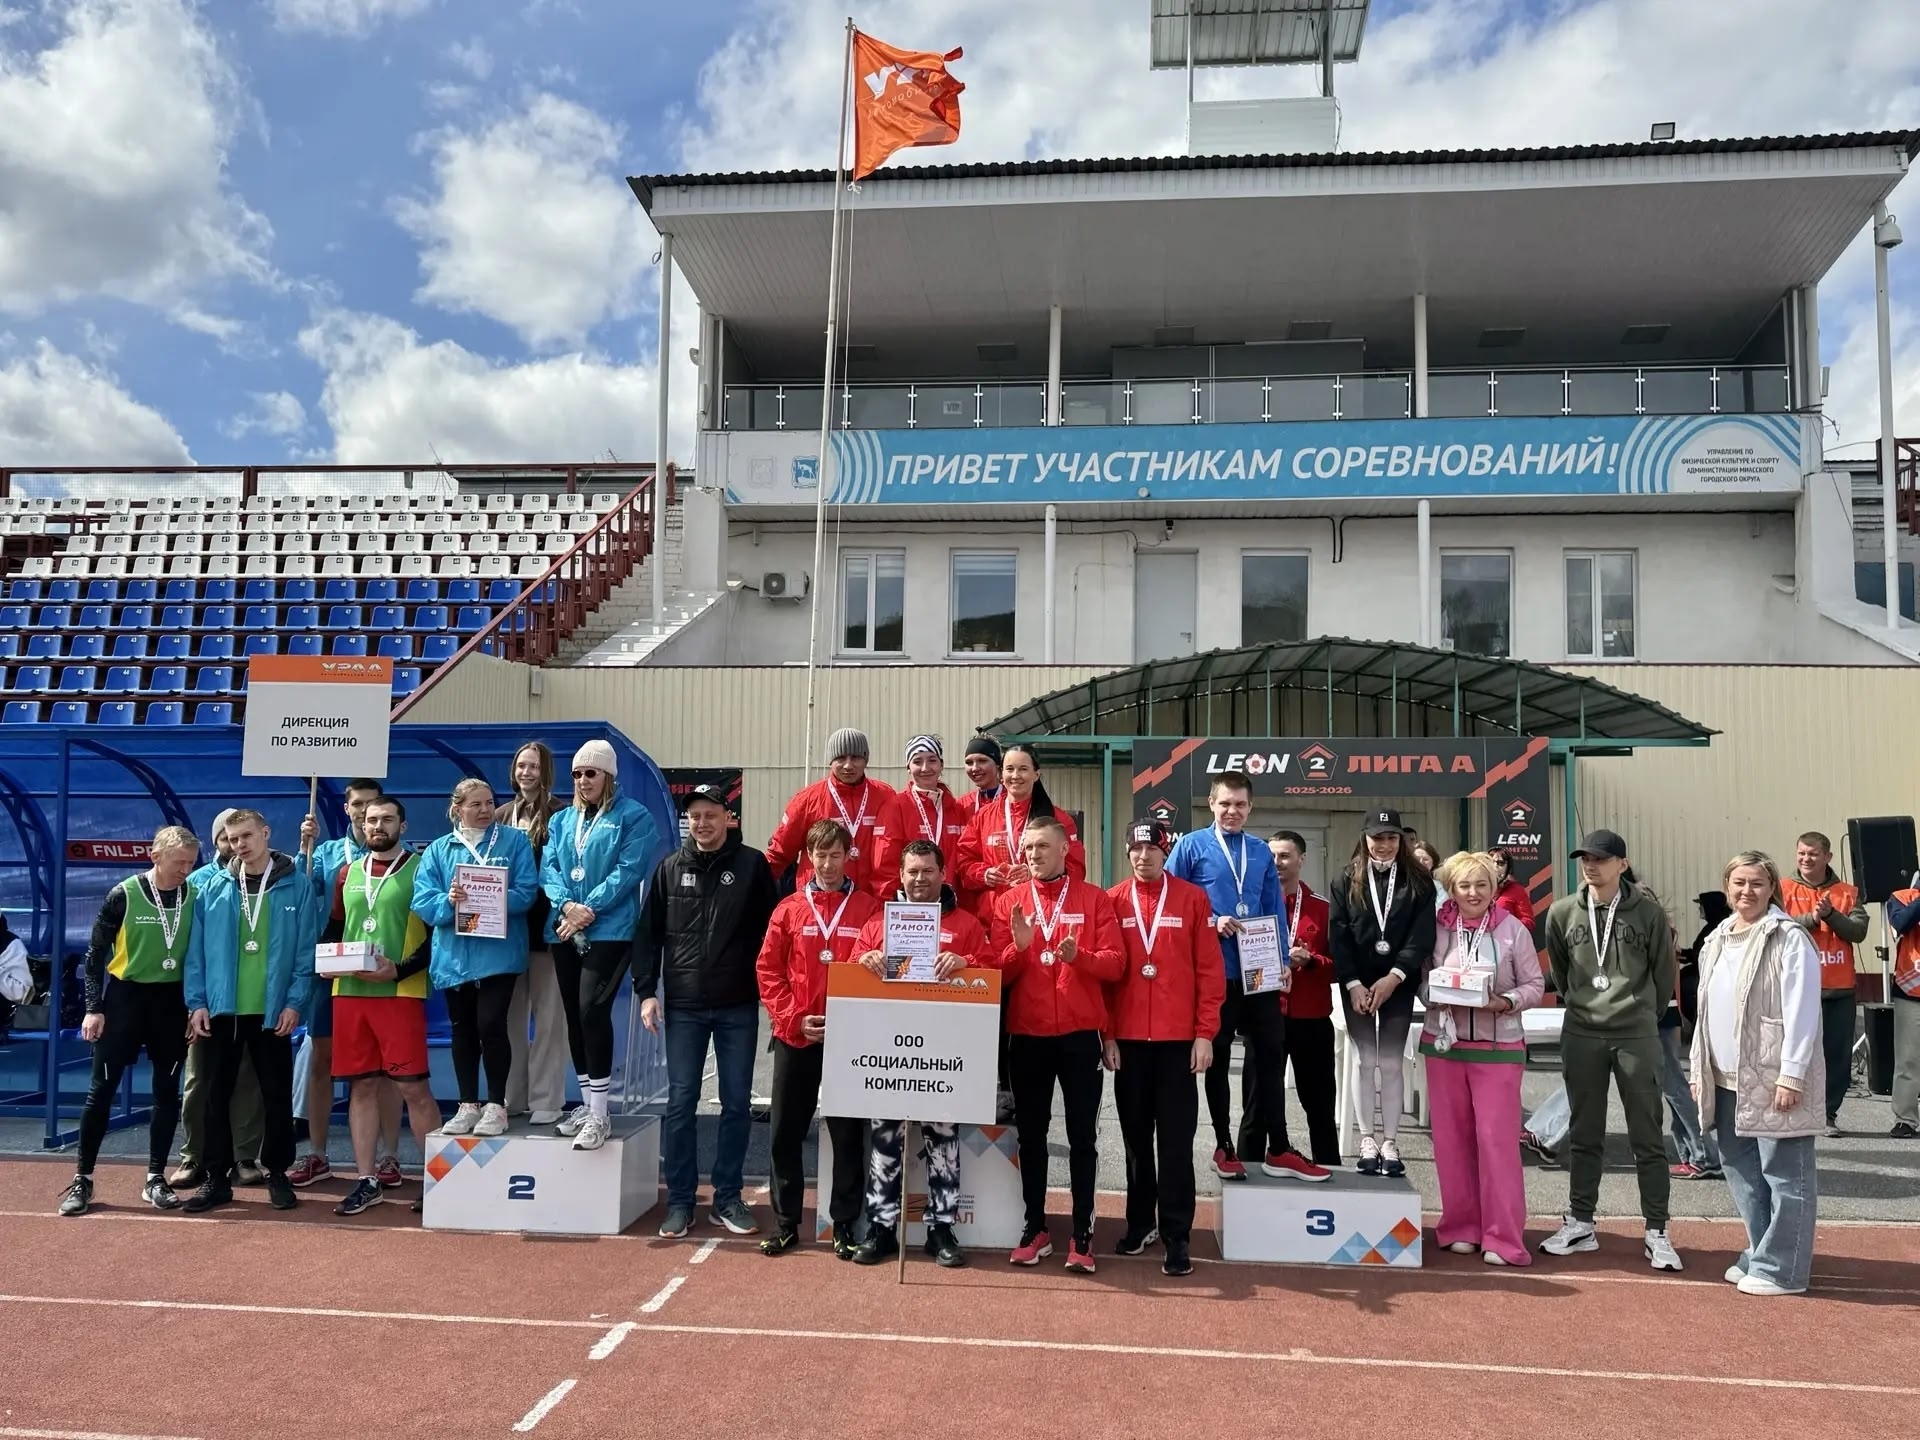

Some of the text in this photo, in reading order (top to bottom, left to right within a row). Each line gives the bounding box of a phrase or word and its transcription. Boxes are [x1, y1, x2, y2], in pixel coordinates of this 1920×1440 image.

[946, 403, 960, 412] VIP
[886, 436, 1619, 485] ПРИВЕТ УЧАСТНИКАМ СОРЕВНОВАНИЙ!
[1681, 457, 1720, 465] ФИЗИЧЕСКОЙ
[281, 717, 349, 729] ДИРЕКЦИЯ
[271, 736, 357, 747] ПО РАЗВИТИЮ
[1310, 757, 1326, 769] 2
[1347, 755, 1476, 773] ЛИГА А
[1156, 808, 1169, 819] 2
[1512, 809, 1526, 820] 2
[461, 883, 503, 893] ГРАМОТА
[889, 923, 935, 932] ГРАМОТА
[1241, 935, 1276, 946] ГРАМОТА
[1820, 951, 1844, 966] ДЬЯ
[894, 1034, 924, 1047] ООО
[851, 1055, 963, 1072] «СОЦИАЛЬНЫЙ
[864, 1077, 954, 1093] КОМПЛЕКС»
[508, 1175, 535, 1200] 2
[954, 1211, 974, 1225] АЛ
[1306, 1209, 1335, 1235] 3
